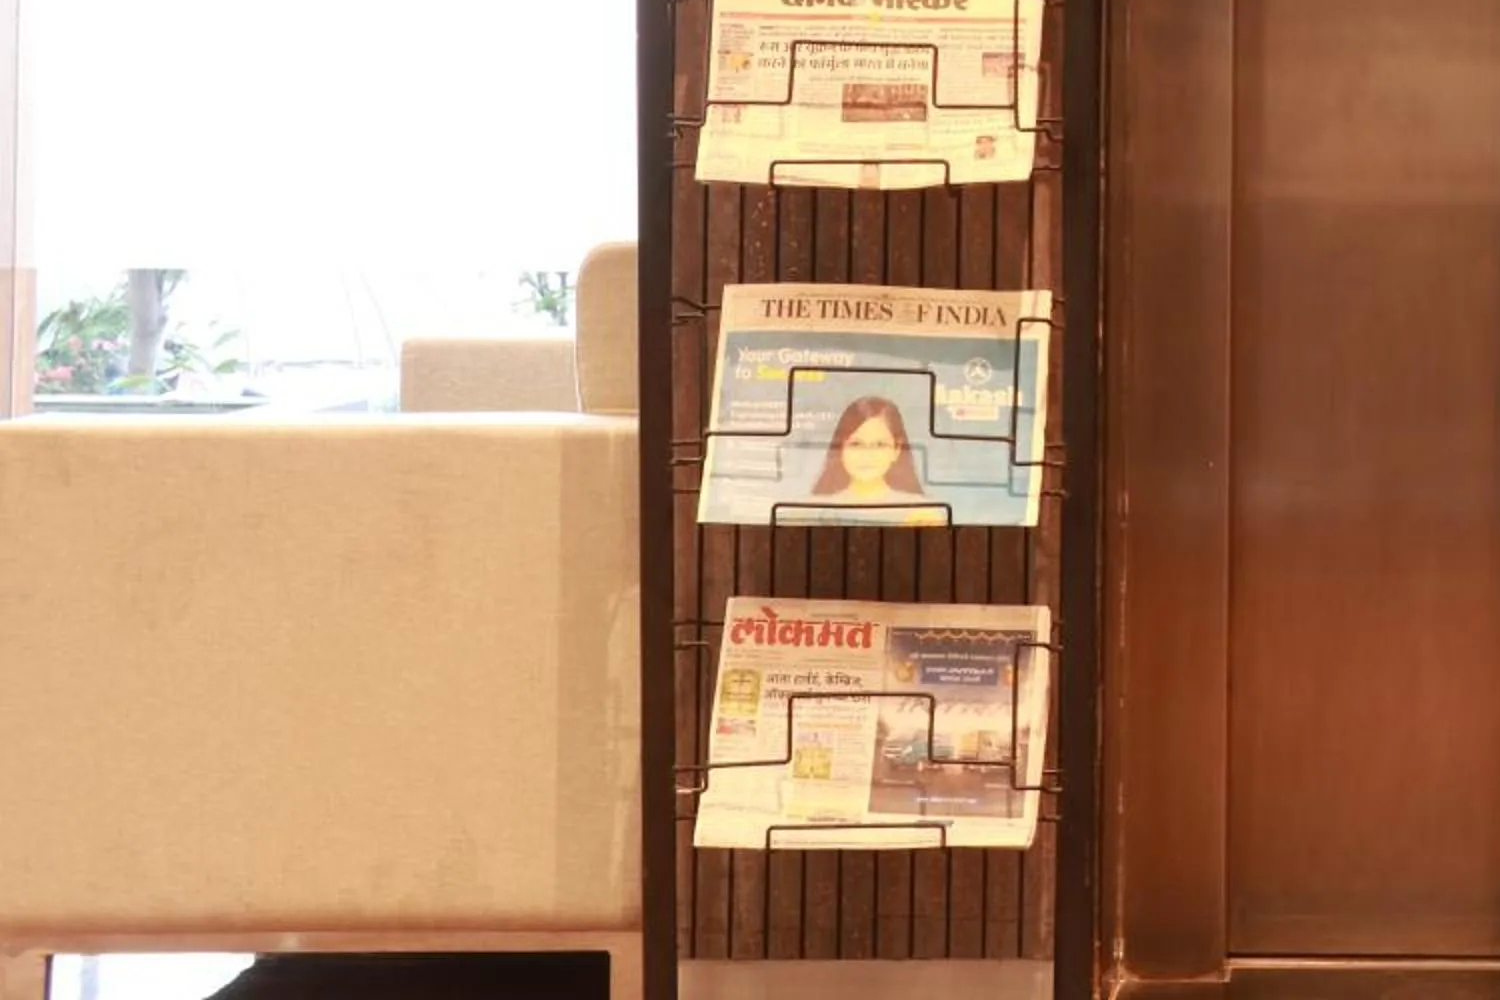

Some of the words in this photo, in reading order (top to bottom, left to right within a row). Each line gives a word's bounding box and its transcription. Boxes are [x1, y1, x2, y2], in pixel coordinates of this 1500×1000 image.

[761, 298, 812, 319] THE
[815, 299, 894, 322] TIMES
[936, 303, 1009, 328] INDIA
[737, 346, 776, 363] Your
[778, 347, 856, 368] Gateway
[735, 364, 752, 381] to
[730, 605, 877, 649] लोकमत
